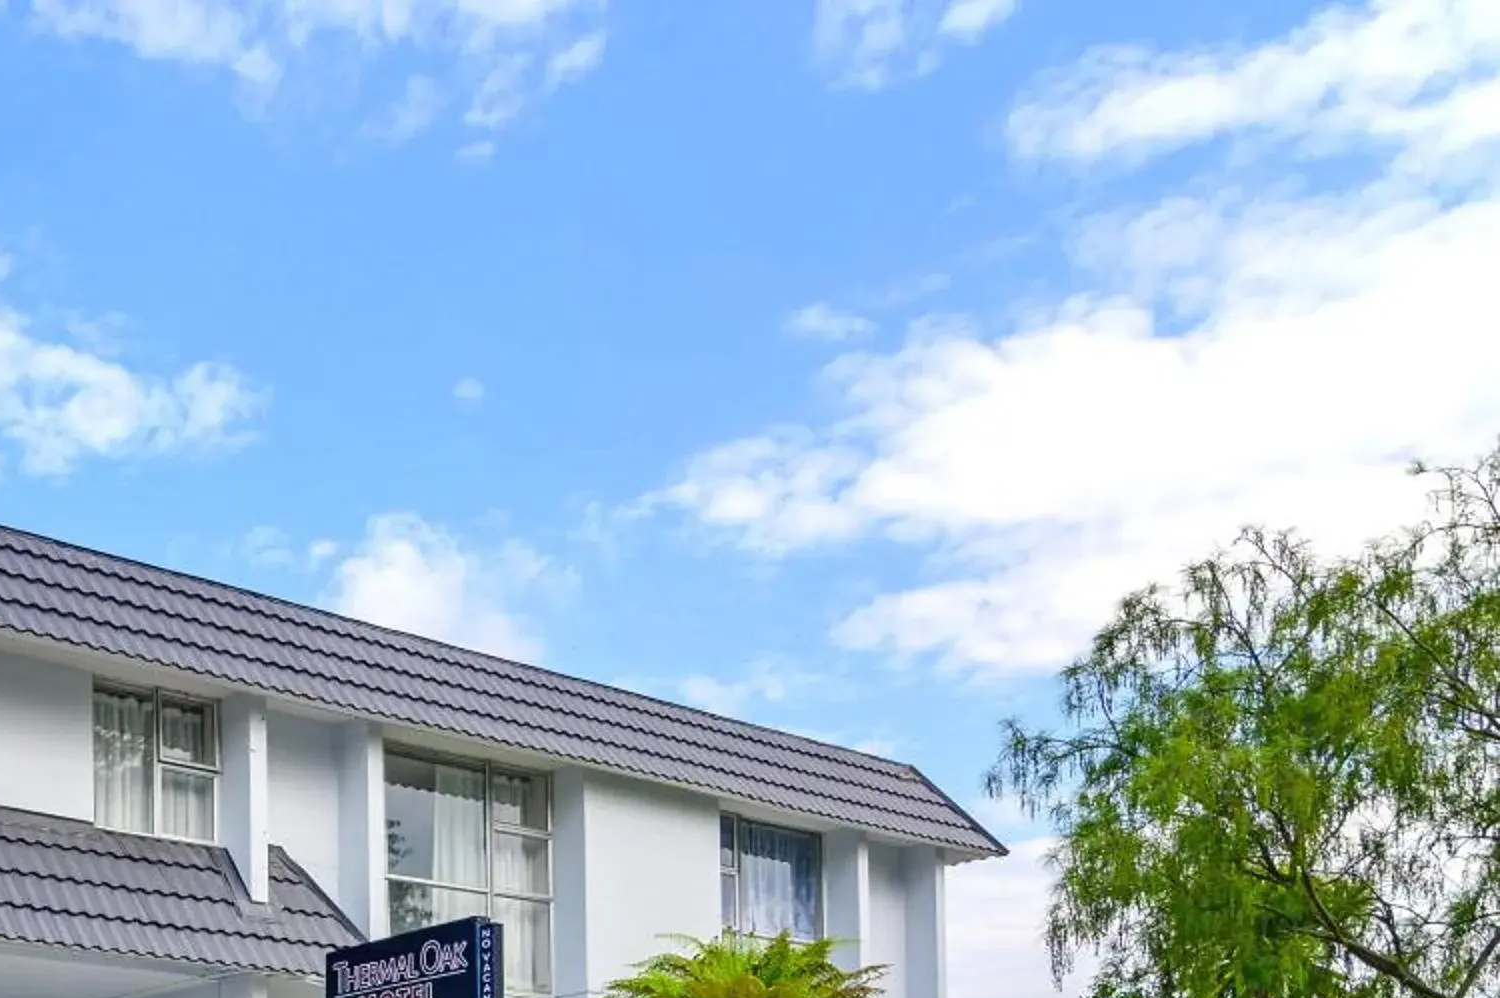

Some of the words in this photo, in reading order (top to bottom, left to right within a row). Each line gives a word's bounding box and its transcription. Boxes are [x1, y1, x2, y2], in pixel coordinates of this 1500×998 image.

[481, 927, 492, 950] NO
[333, 952, 420, 994] THERMAL
[420, 939, 469, 974] OAK
